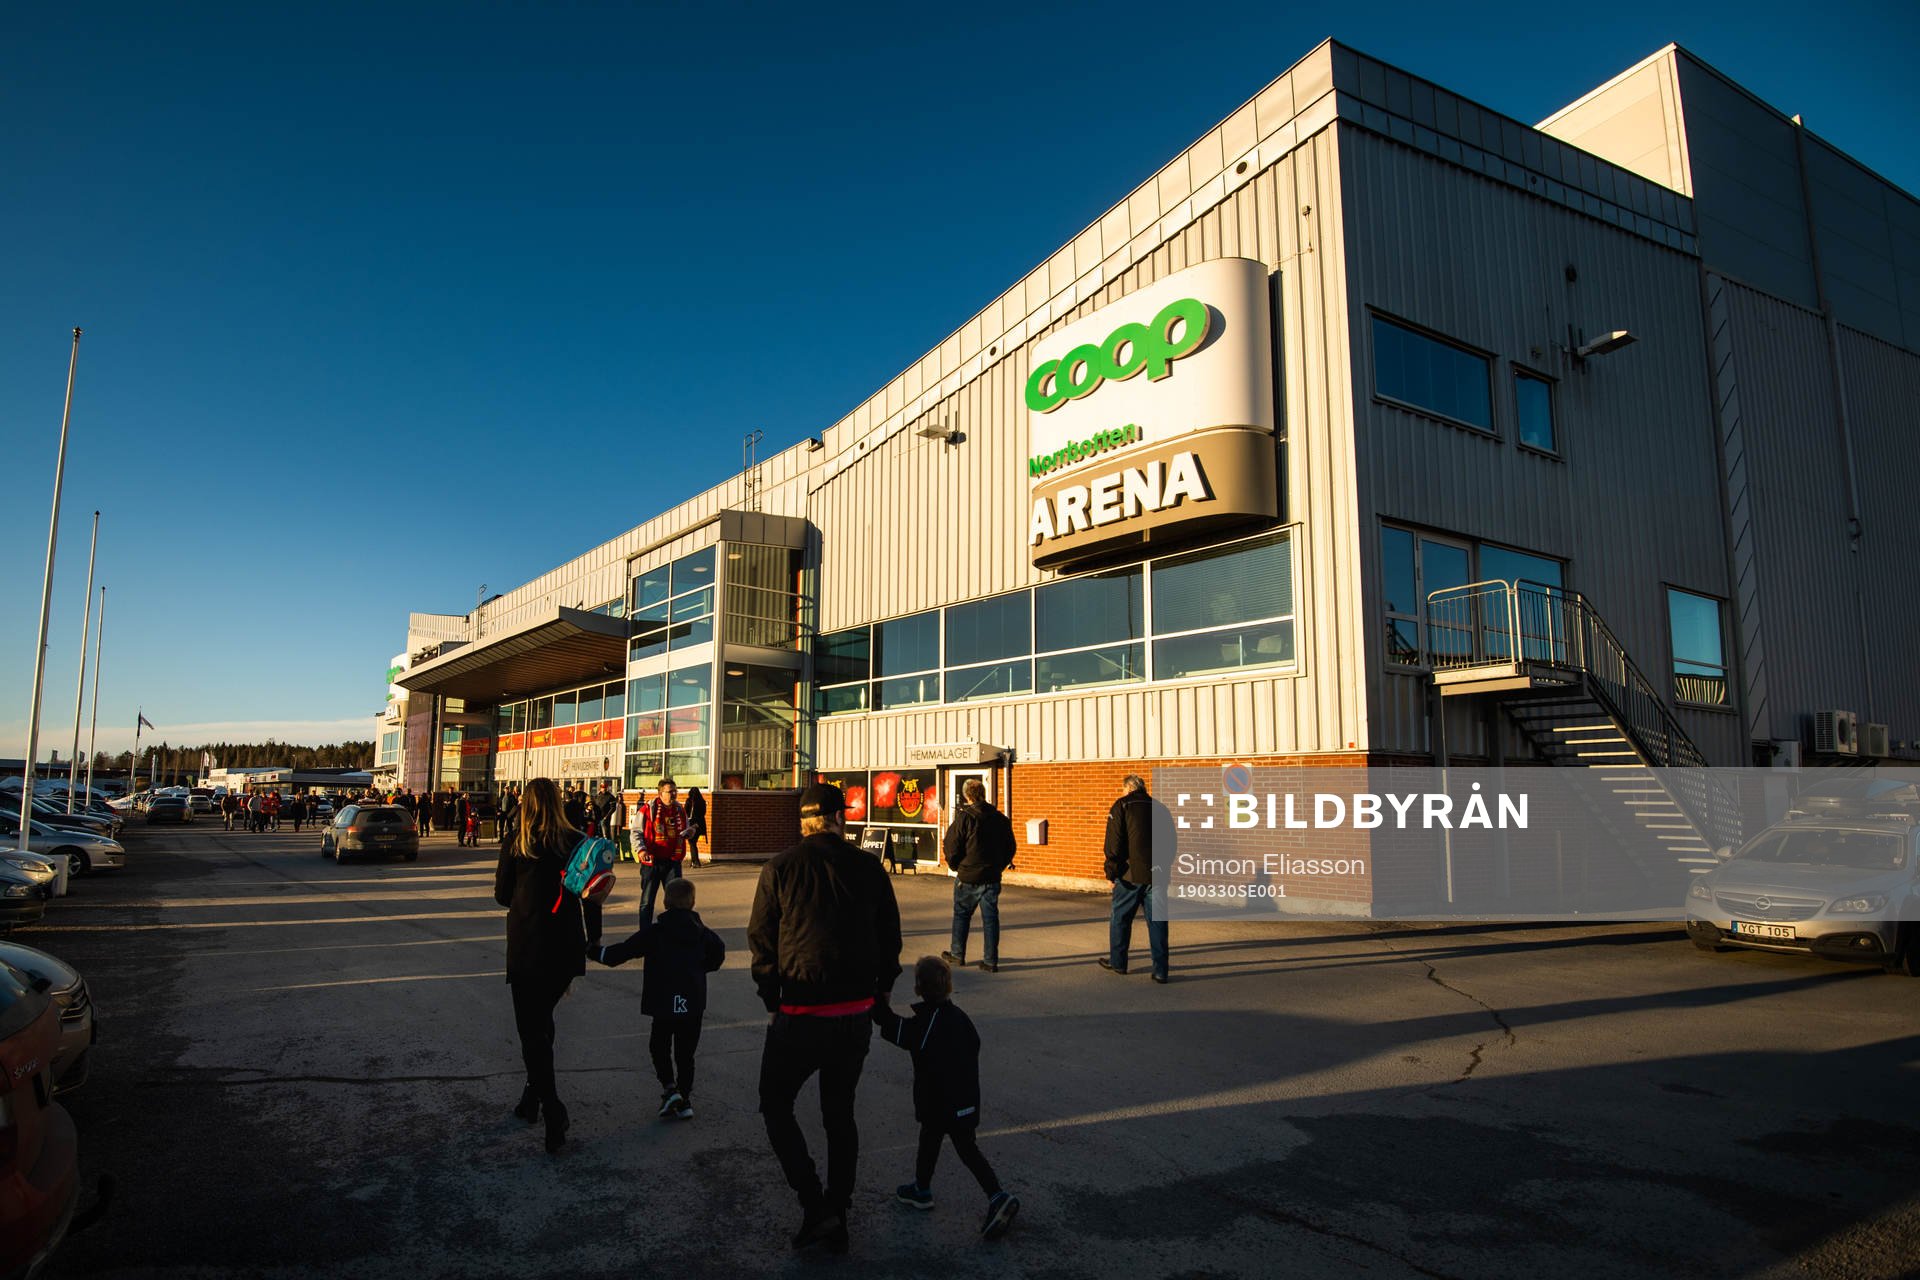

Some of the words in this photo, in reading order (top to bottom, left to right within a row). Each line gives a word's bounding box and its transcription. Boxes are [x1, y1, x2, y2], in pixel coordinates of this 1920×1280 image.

[1025, 297, 1210, 414] coop
[1029, 422, 1140, 477] Norrbotten
[1028, 450, 1209, 546] ARENA
[910, 747, 972, 761] HEMMALAGET
[863, 839, 884, 849] ÖPPET
[1741, 923, 1763, 935] YGT
[1768, 927, 1790, 938] 105
[673, 995, 688, 1013] k
